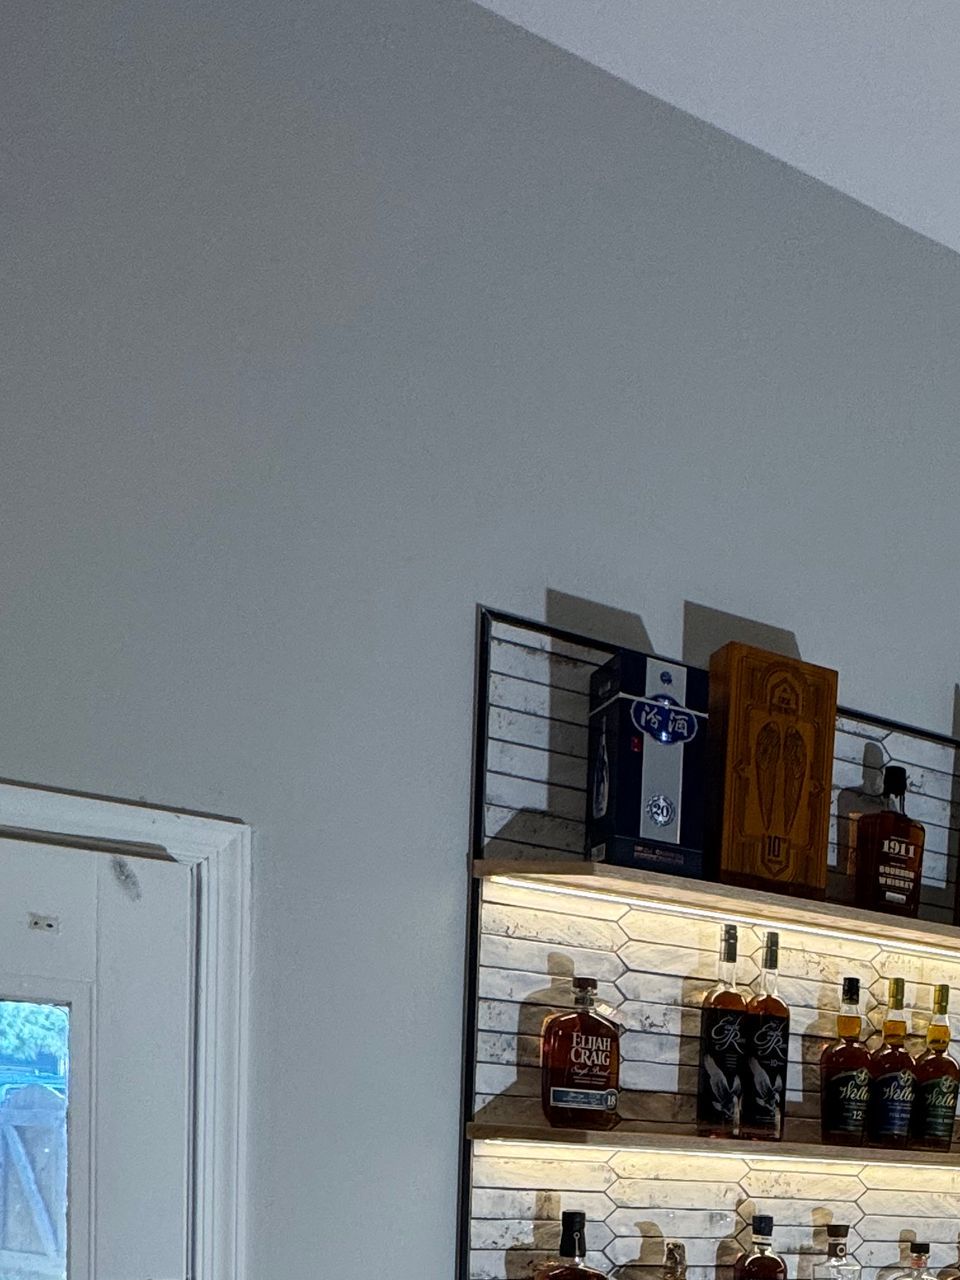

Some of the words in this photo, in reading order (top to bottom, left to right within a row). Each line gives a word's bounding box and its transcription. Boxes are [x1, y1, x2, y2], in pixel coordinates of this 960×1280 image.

[641, 704, 688, 736] 汾酒
[653, 803, 669, 818] 20
[882, 840, 915, 858] 1911
[571, 1032, 611, 1051] ELIJAH
[571, 1047, 610, 1066] CRAIG
[607, 1095, 617, 1106] 18
[852, 1110, 864, 1120] 12
